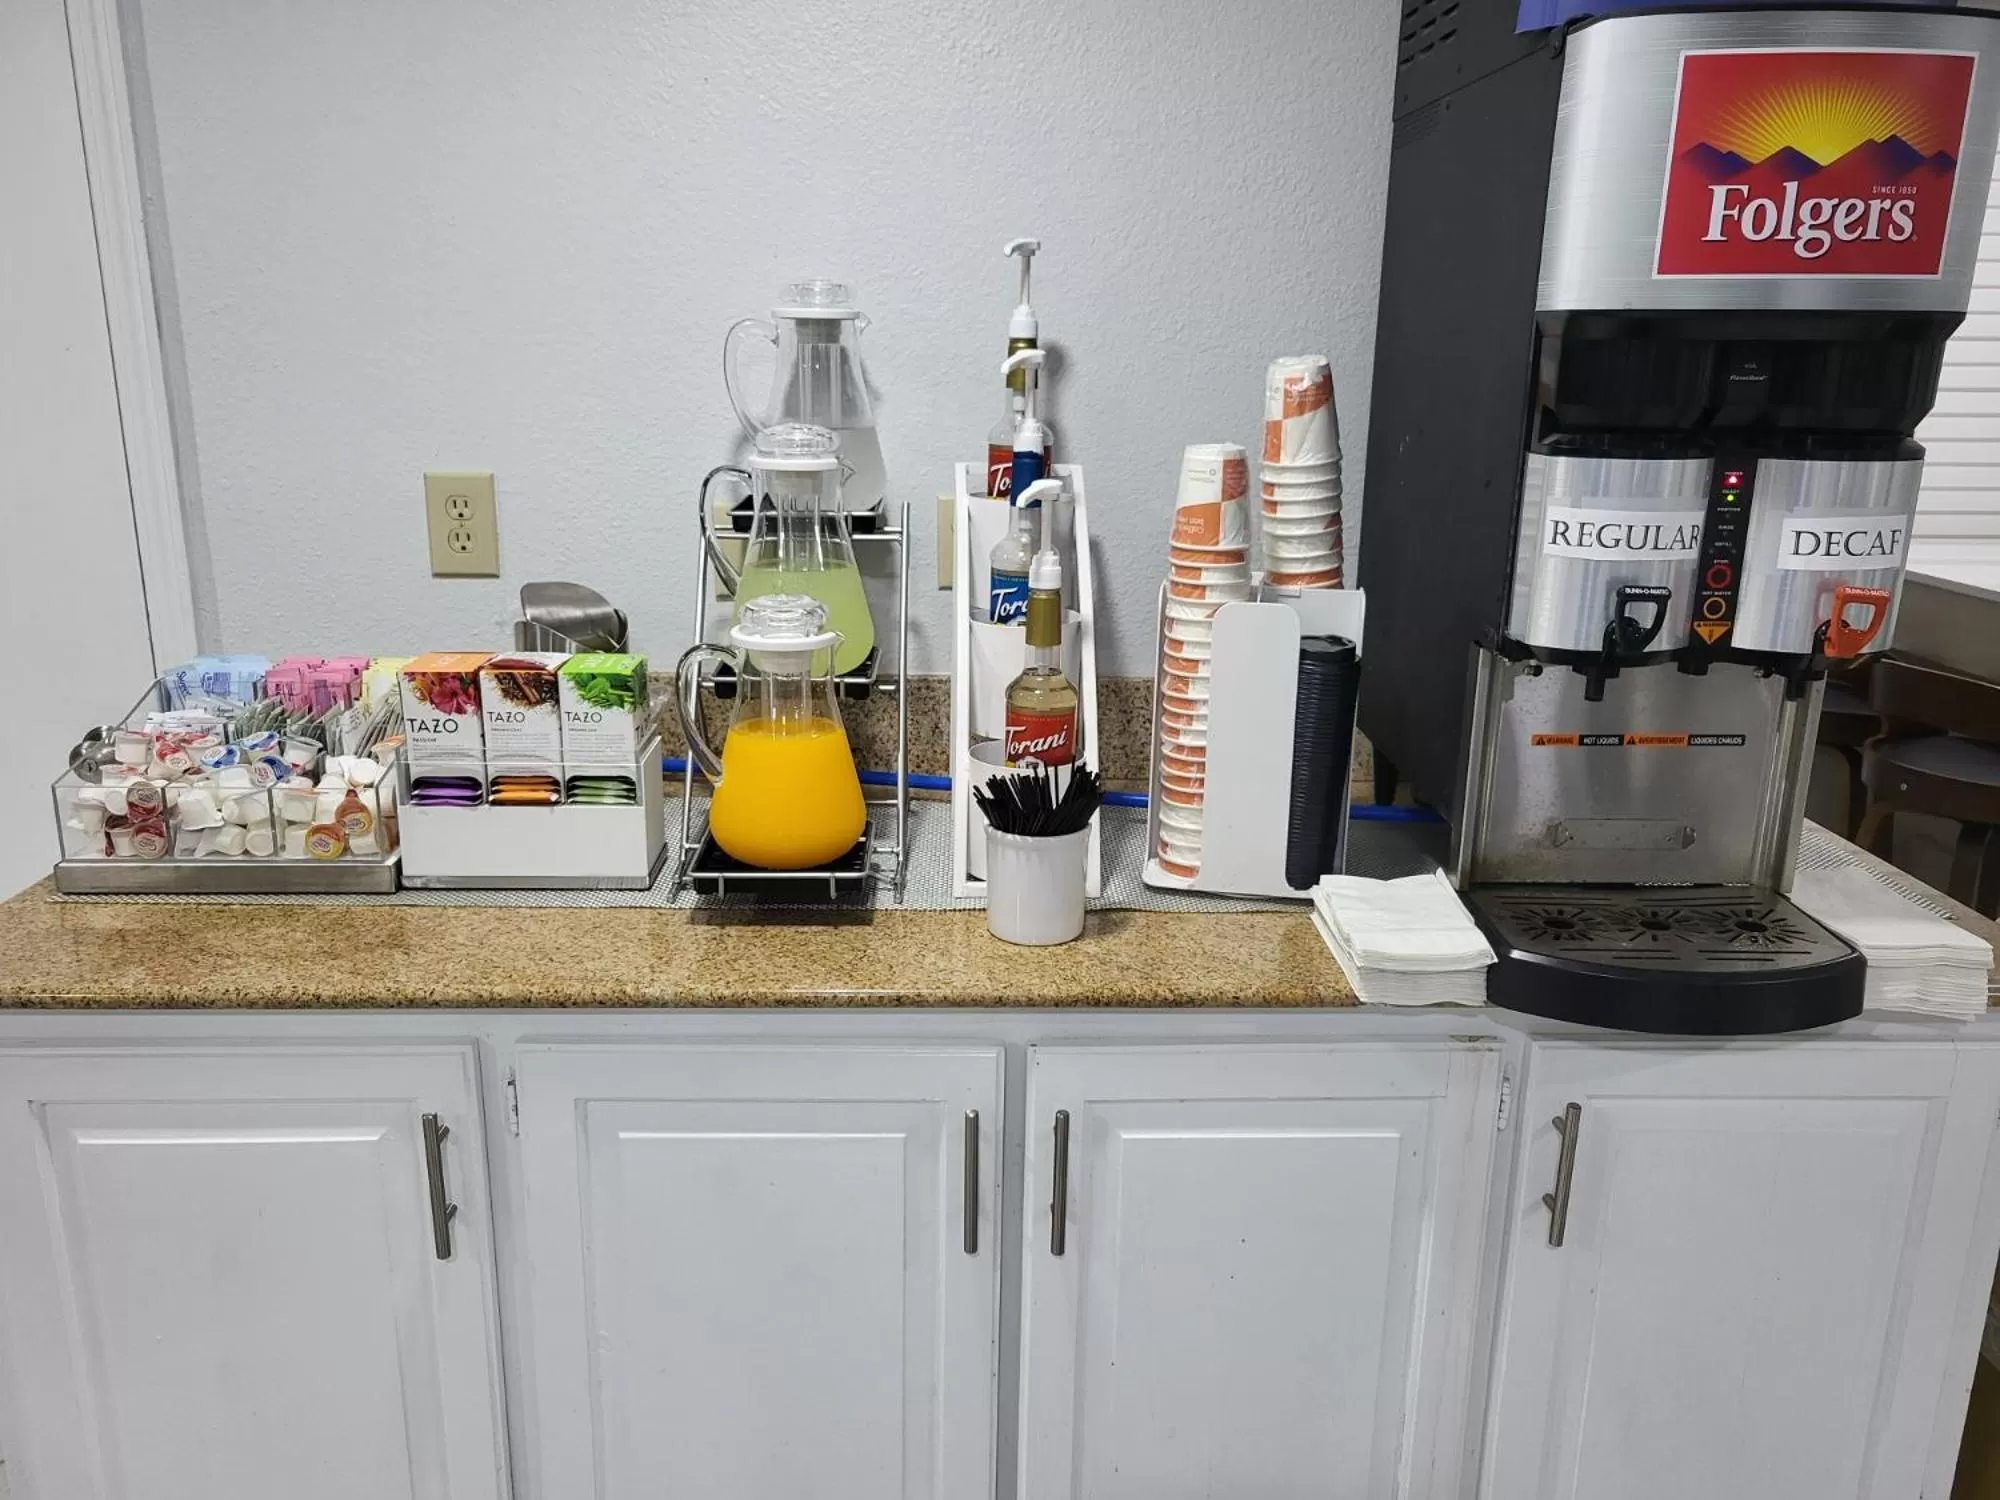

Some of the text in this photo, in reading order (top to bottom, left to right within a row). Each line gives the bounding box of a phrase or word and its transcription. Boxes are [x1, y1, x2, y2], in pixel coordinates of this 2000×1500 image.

[1871, 185, 1896, 194] SINCE
[1701, 180, 1915, 258] Folgers
[1548, 519, 1700, 550] REGULAR
[1788, 529, 1902, 556] DECAF
[406, 718, 458, 734] TAZO
[486, 711, 525, 724] TAZO
[564, 711, 603, 724] TAZO
[1005, 724, 1068, 760] Torani
